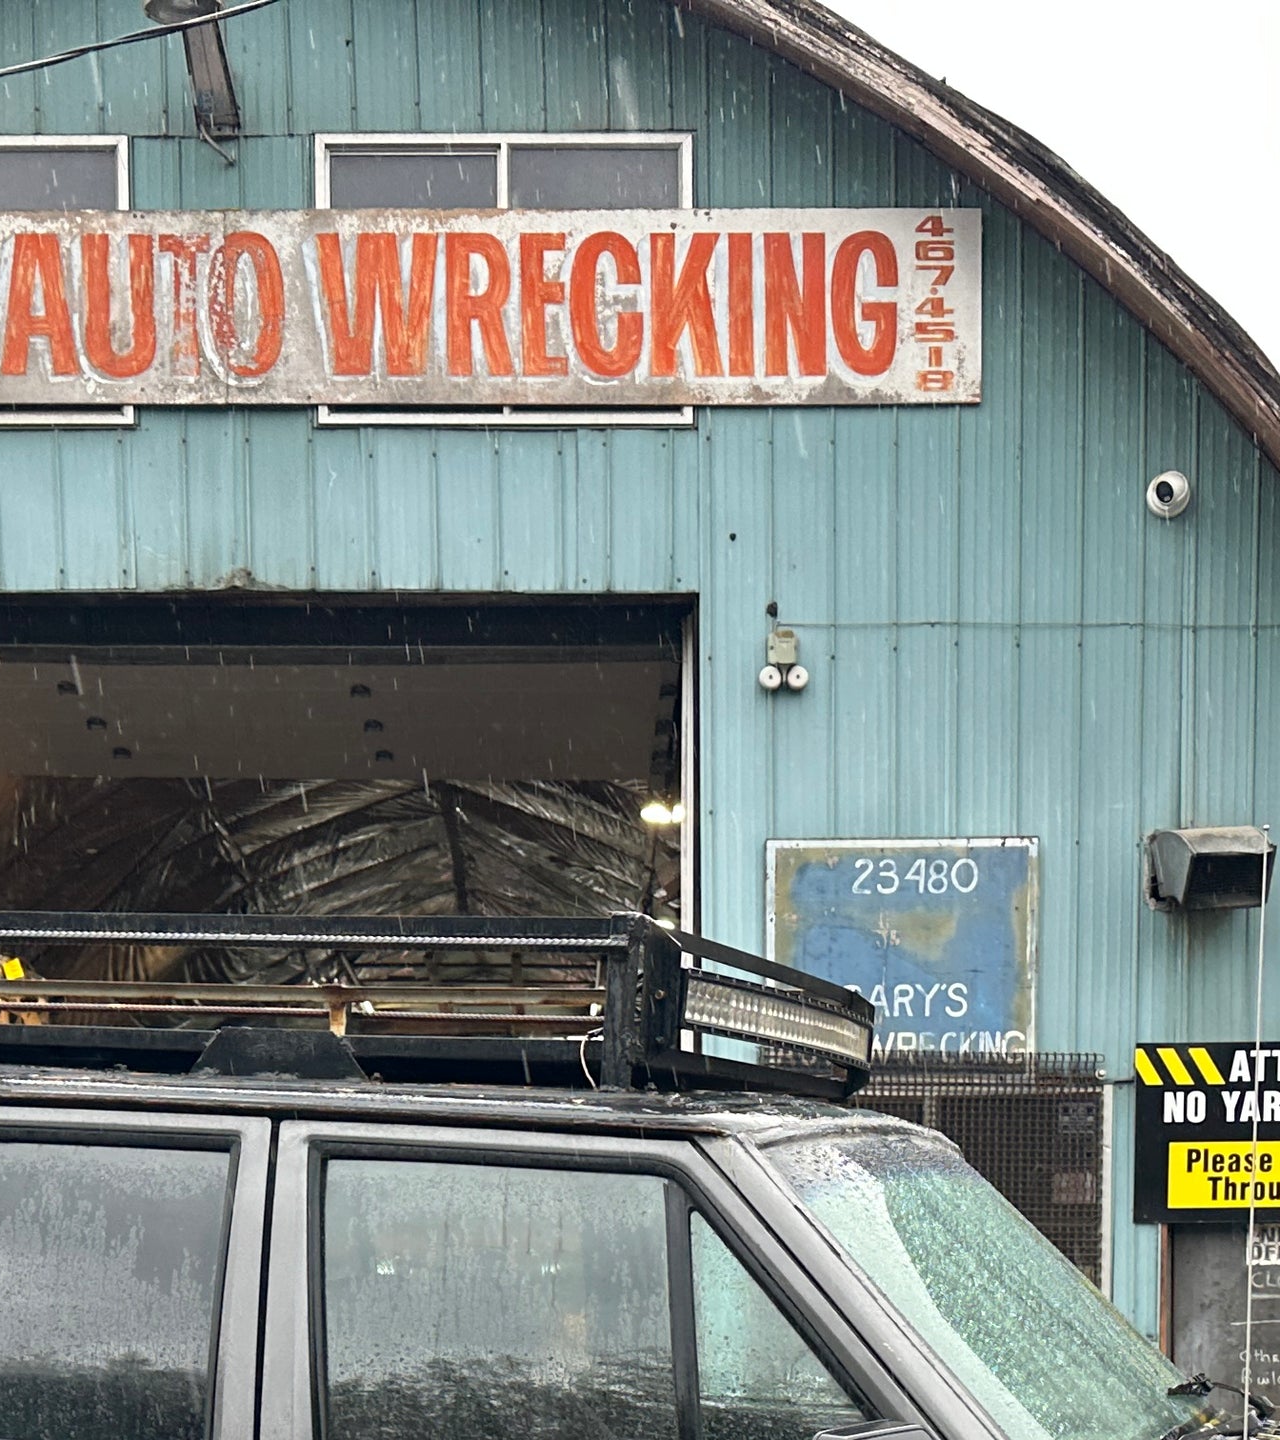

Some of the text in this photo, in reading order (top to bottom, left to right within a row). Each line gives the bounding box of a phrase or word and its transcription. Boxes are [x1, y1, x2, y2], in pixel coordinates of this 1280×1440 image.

[0, 231, 287, 379] AUTO
[314, 230, 900, 379] WRECKING
[851, 858, 979, 895] 23480
[1163, 1090, 1207, 1123] NO
[1186, 1148, 1273, 1173] Please
